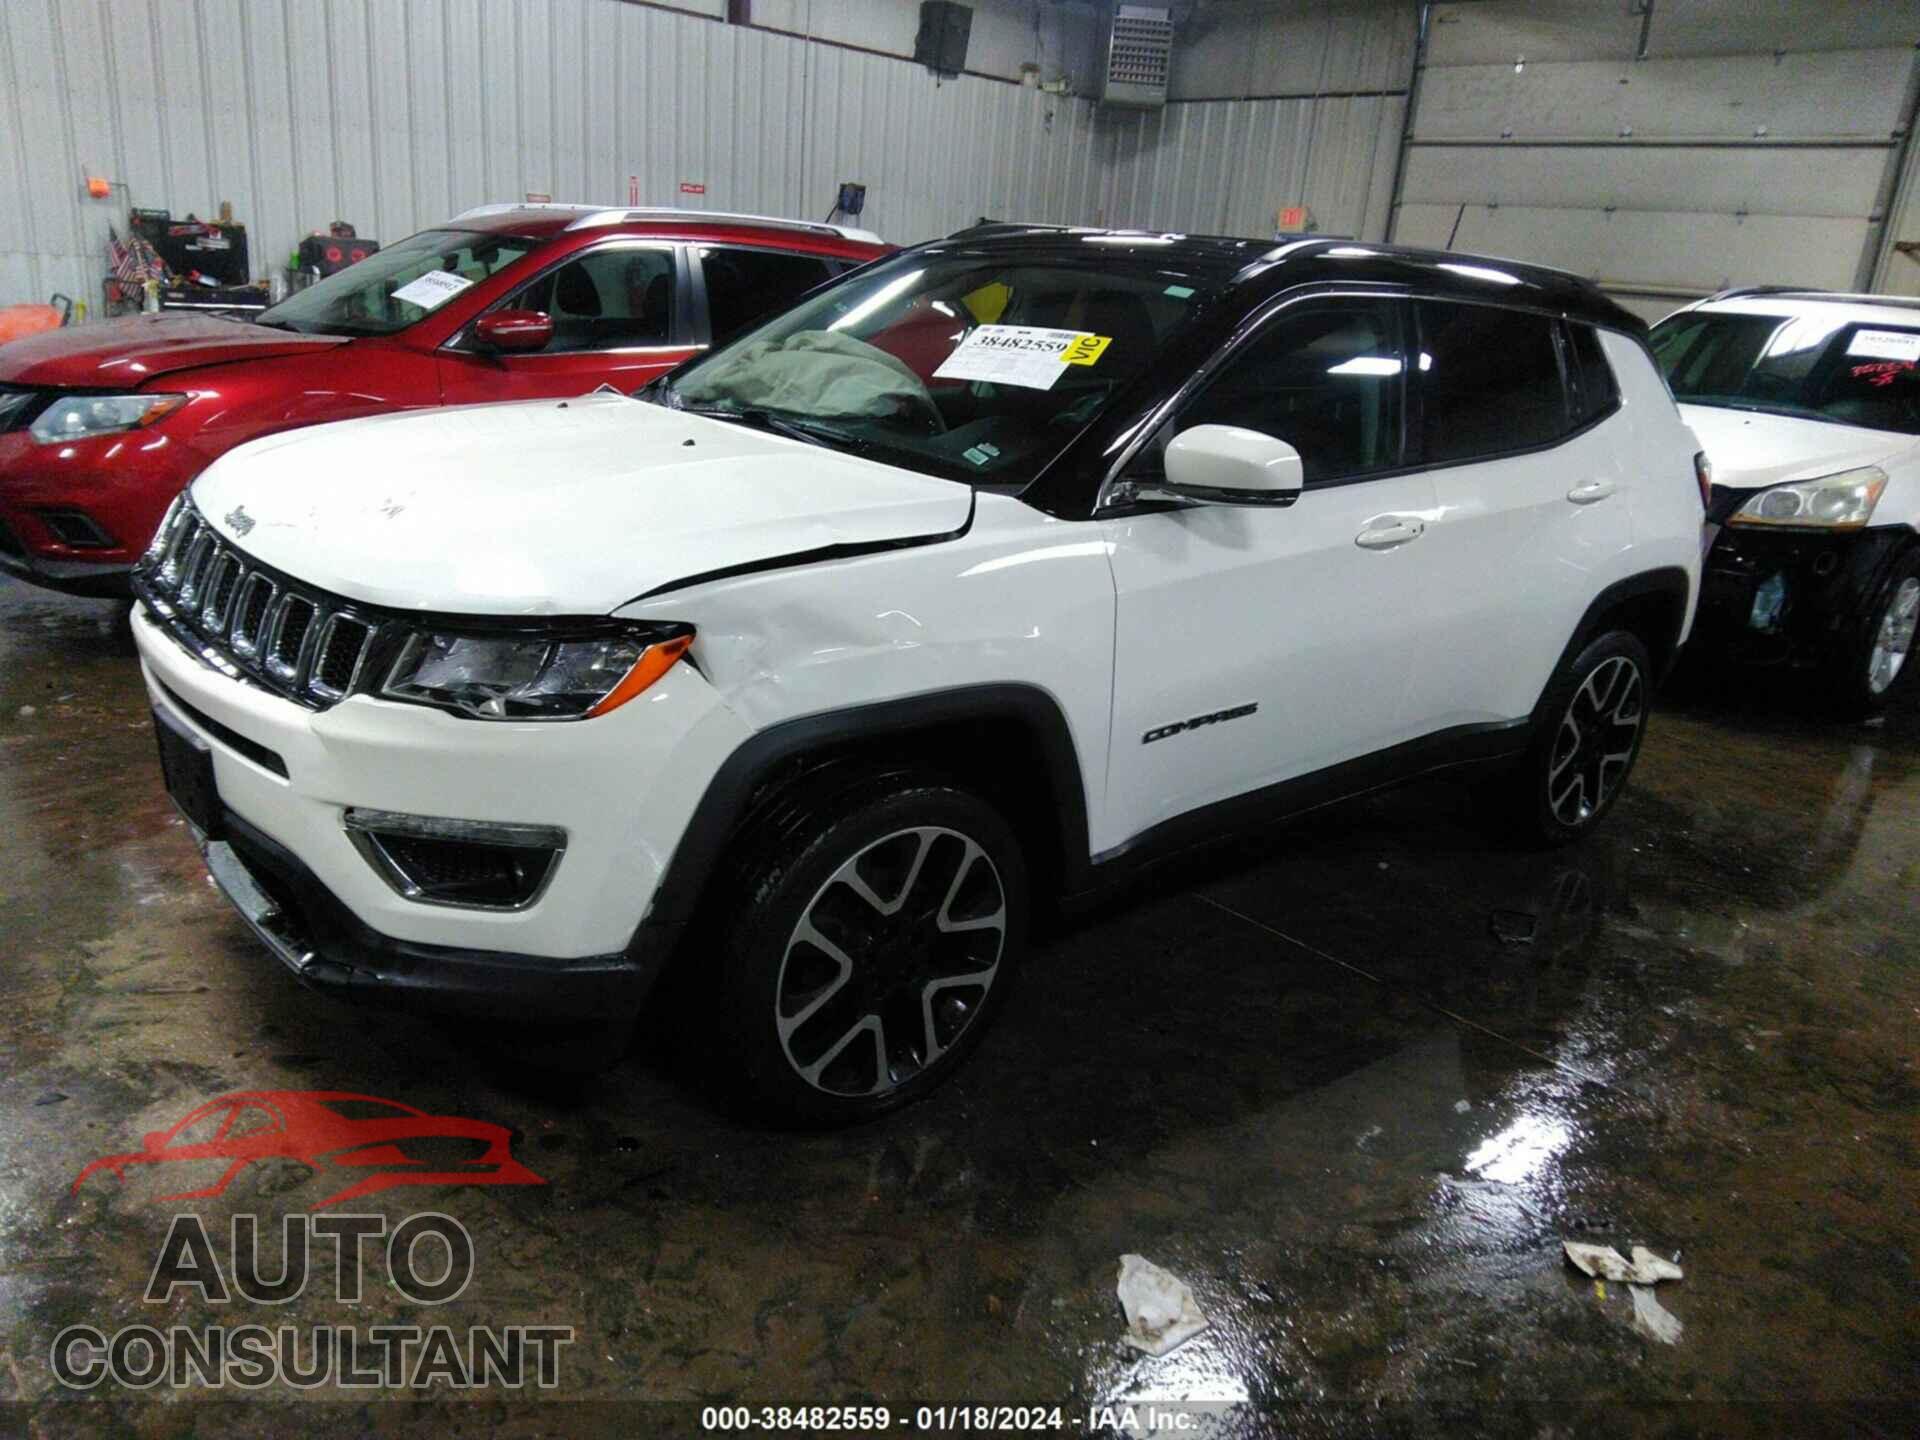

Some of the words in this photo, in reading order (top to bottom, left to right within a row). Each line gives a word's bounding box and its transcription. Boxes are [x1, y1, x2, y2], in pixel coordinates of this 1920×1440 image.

[973, 336, 1068, 352] 38482559
[1070, 338, 1101, 361] VIC
[1142, 702, 1259, 744] COMPASS
